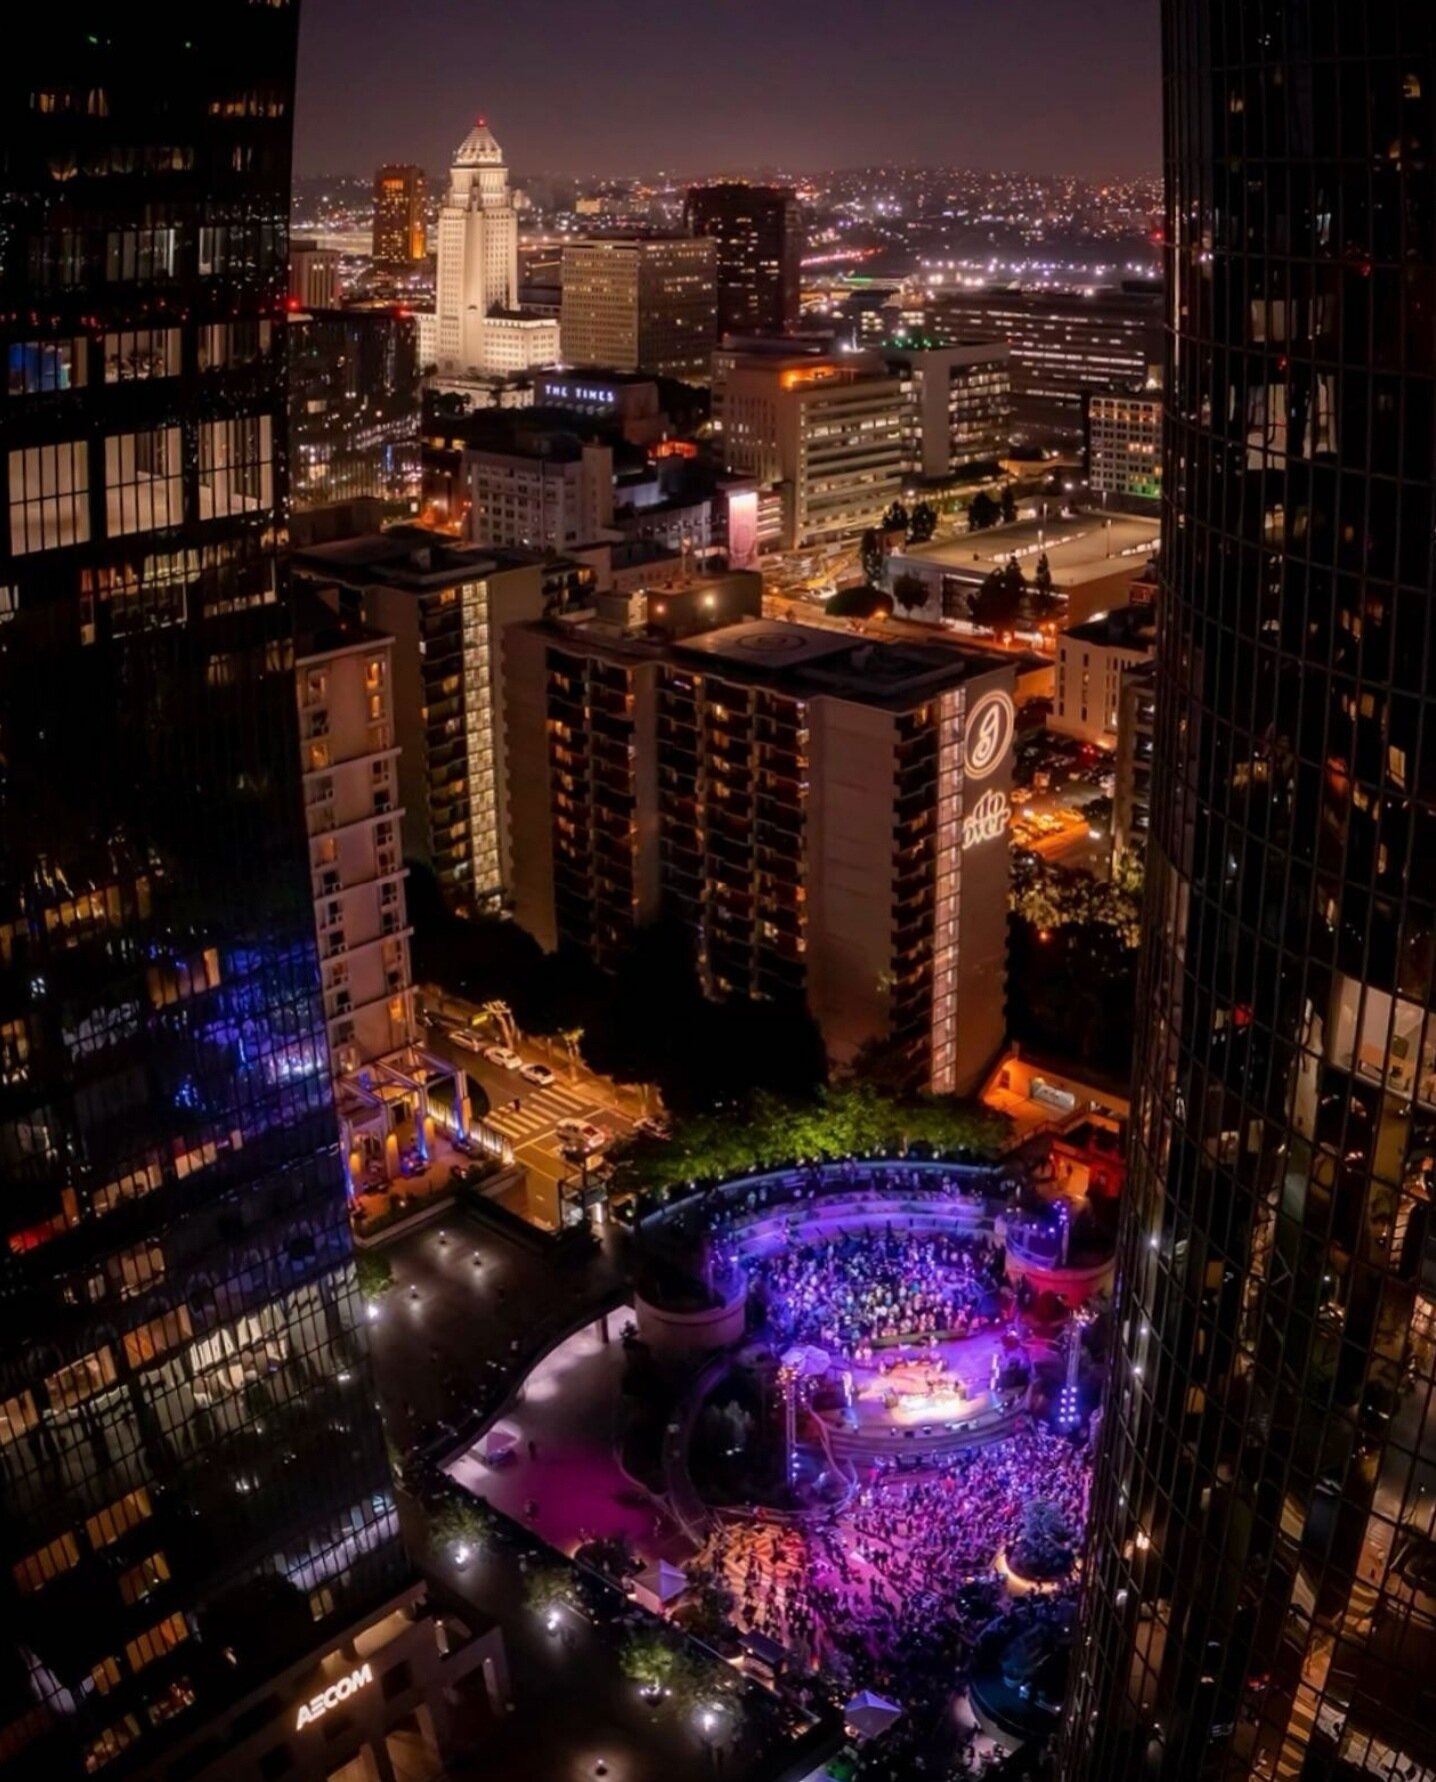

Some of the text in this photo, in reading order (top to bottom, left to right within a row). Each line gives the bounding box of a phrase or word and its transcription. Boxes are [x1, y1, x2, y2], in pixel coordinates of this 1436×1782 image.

[545, 385, 614, 402] THE TIMES
[296, 1663, 373, 1731] AECOM
